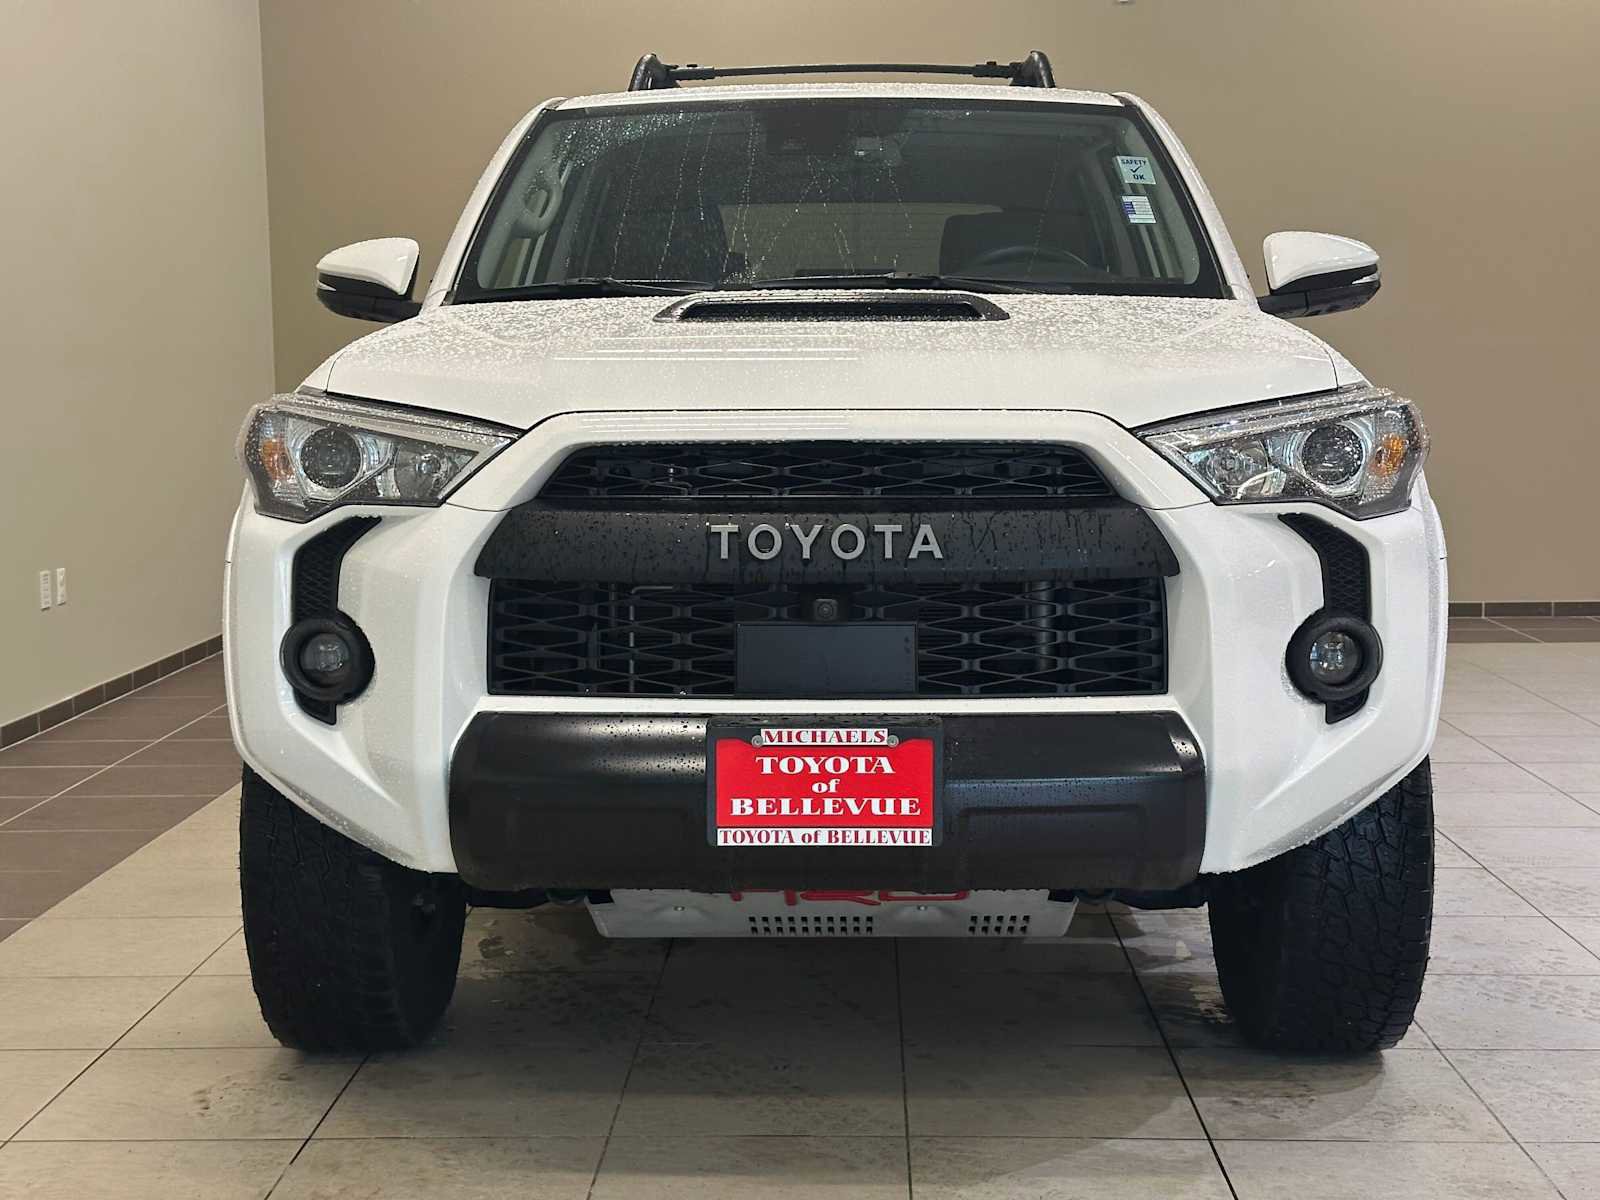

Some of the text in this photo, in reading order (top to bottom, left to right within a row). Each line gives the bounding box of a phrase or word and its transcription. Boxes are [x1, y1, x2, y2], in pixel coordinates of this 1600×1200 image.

[710, 523, 943, 560] TOYOTA
[764, 730, 886, 743] MICHAELS
[756, 756, 895, 774] TOYOTA
[811, 778, 840, 793] of
[730, 798, 920, 815] BELLEVUE
[719, 830, 930, 844] TOYOTA of BELLEVUE
